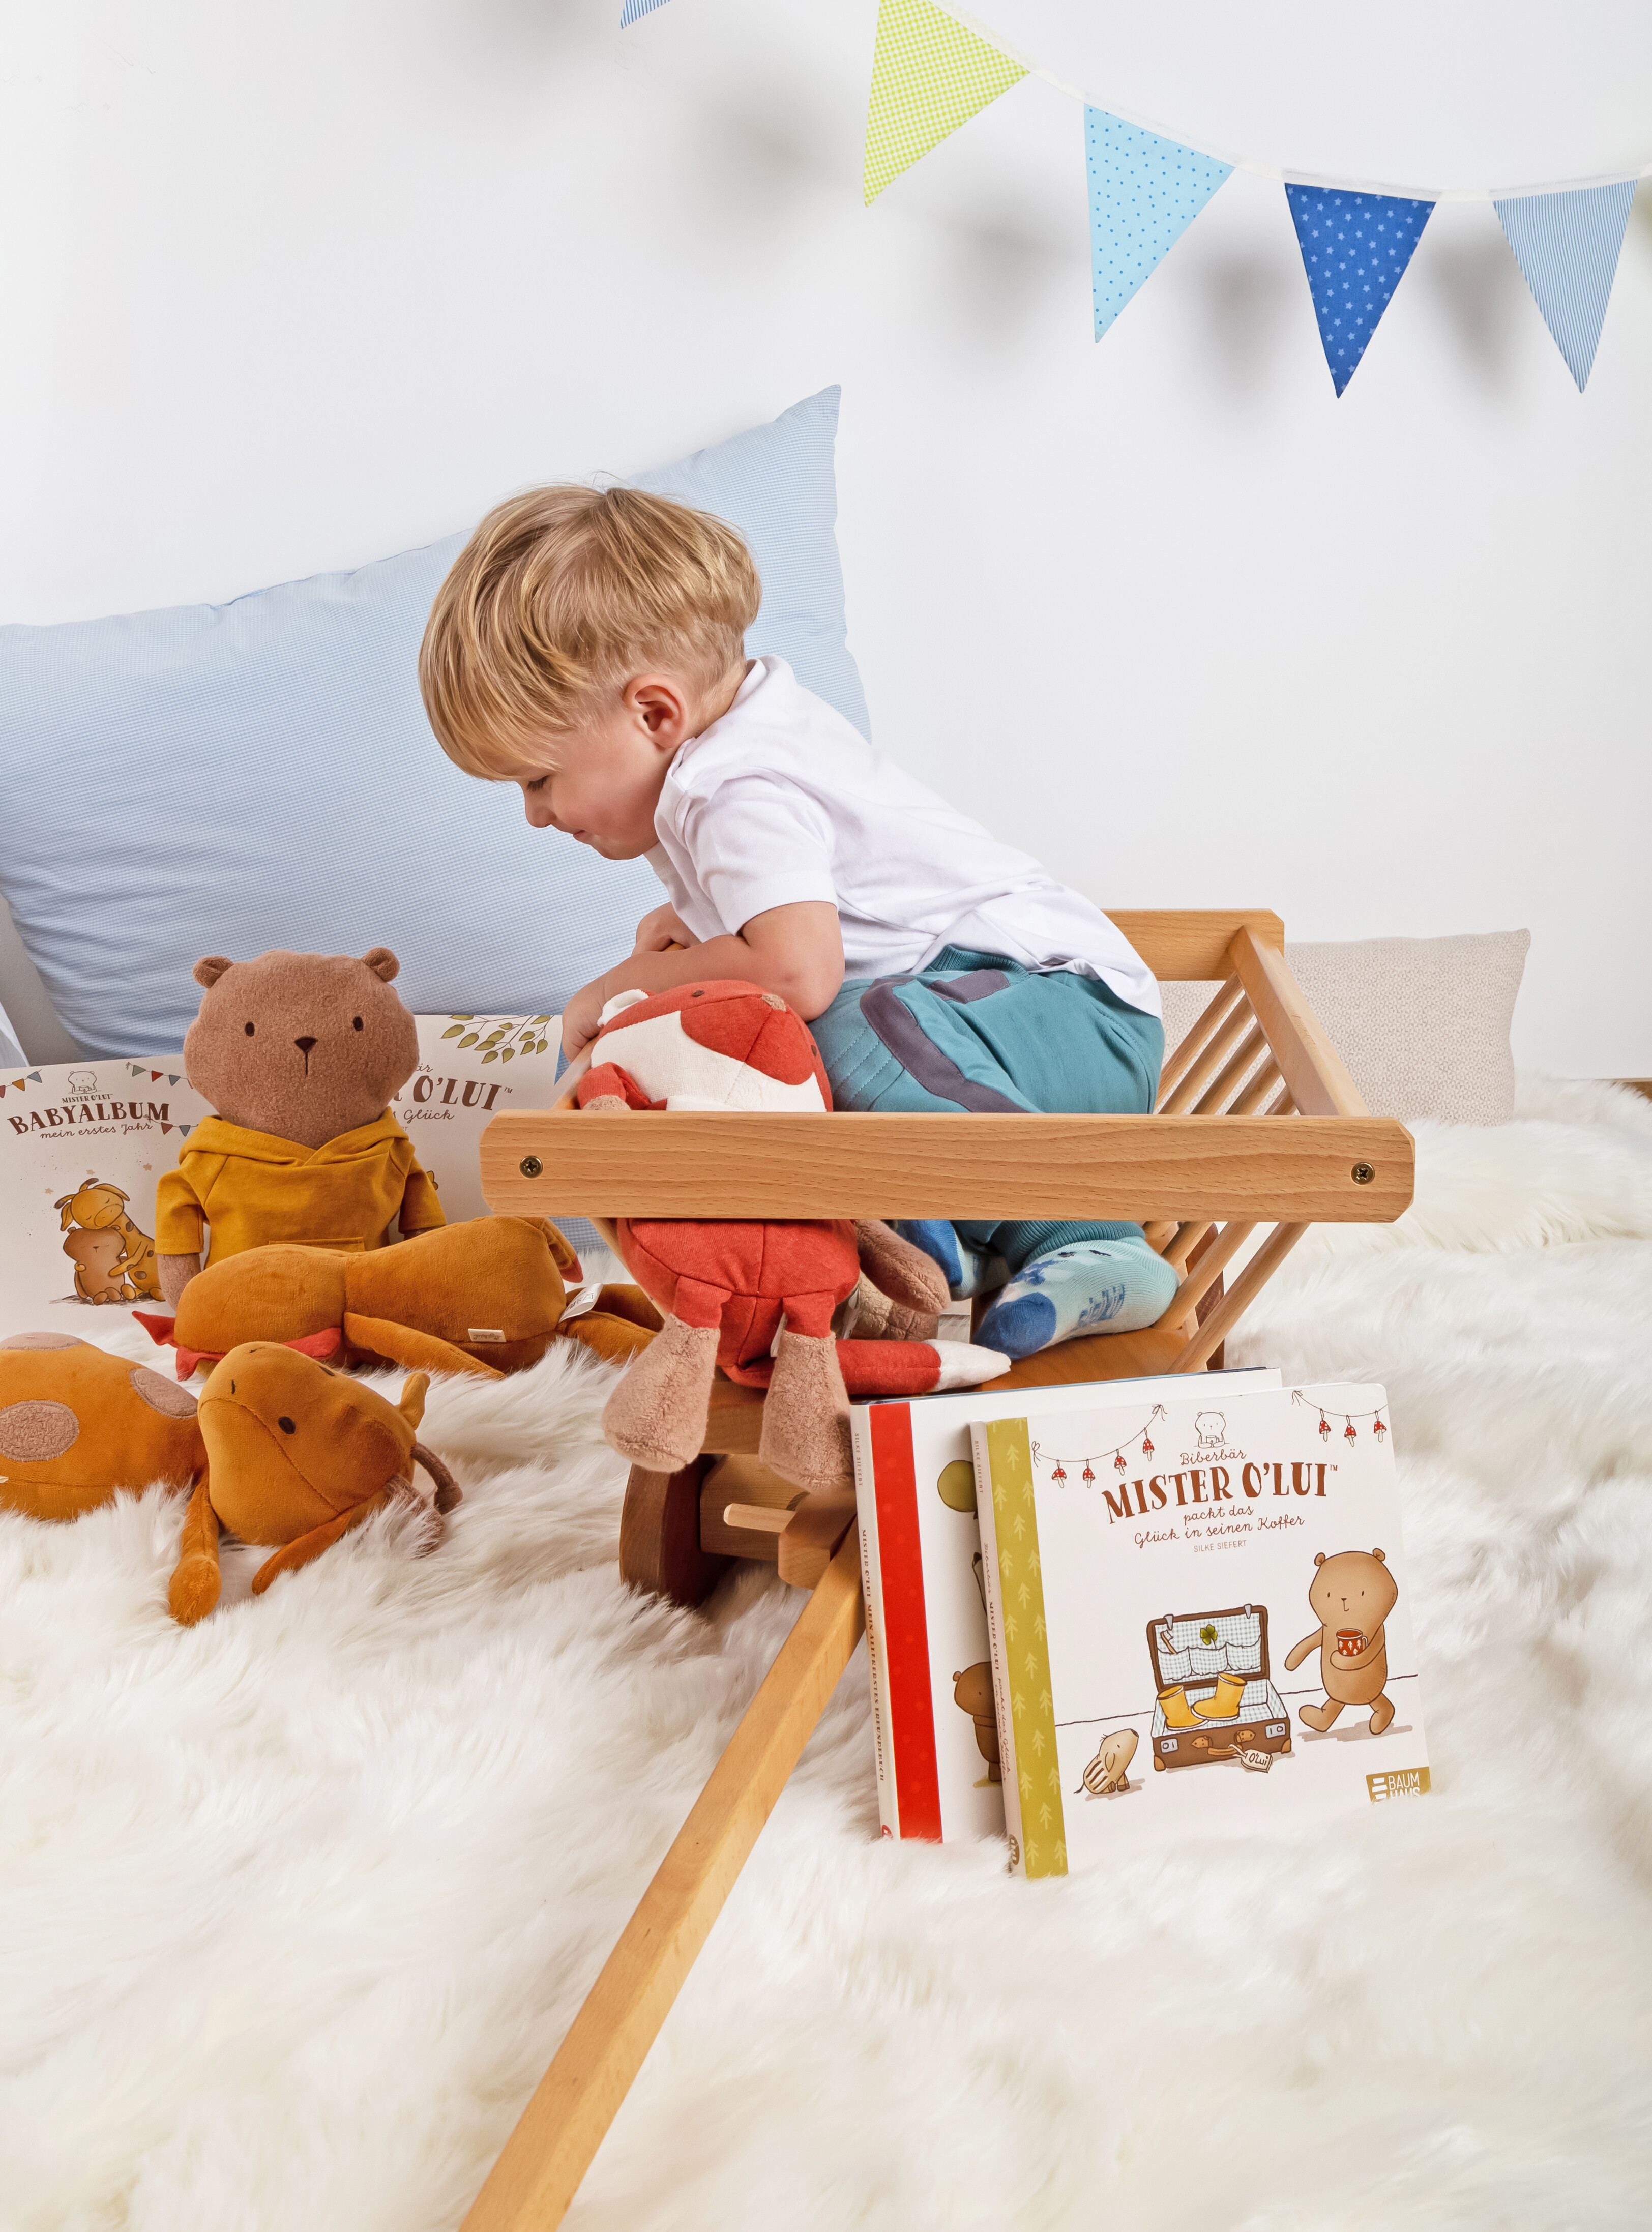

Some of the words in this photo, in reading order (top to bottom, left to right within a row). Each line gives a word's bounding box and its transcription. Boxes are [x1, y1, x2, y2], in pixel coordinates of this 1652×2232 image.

[7, 1102, 169, 1135] BABYALBUM
[404, 1109, 454, 1124] Glück
[40, 1130, 75, 1138] mein
[78, 1126, 116, 1135] erstes
[121, 1122, 153, 1135] Jahr
[1180, 1449, 1246, 1465] Biberbär
[1101, 1466, 1233, 1524] MISTER
[1183, 1506, 1225, 1525] packt
[1229, 1505, 1254, 1516] das
[1134, 1528, 1180, 1548] Glück
[1185, 1526, 1202, 1538] in
[1205, 1523, 1253, 1536] seinen
[1257, 1514, 1305, 1530] Koffer
[1194, 1543, 1214, 1552] SILKE
[1217, 1540, 1247, 1550] SIEFERT
[870, 1633, 879, 1704] ALLERERSTES
[875, 1707, 884, 1781] FREUNDEBUCH
[1388, 1772, 1420, 1790] BAUM
